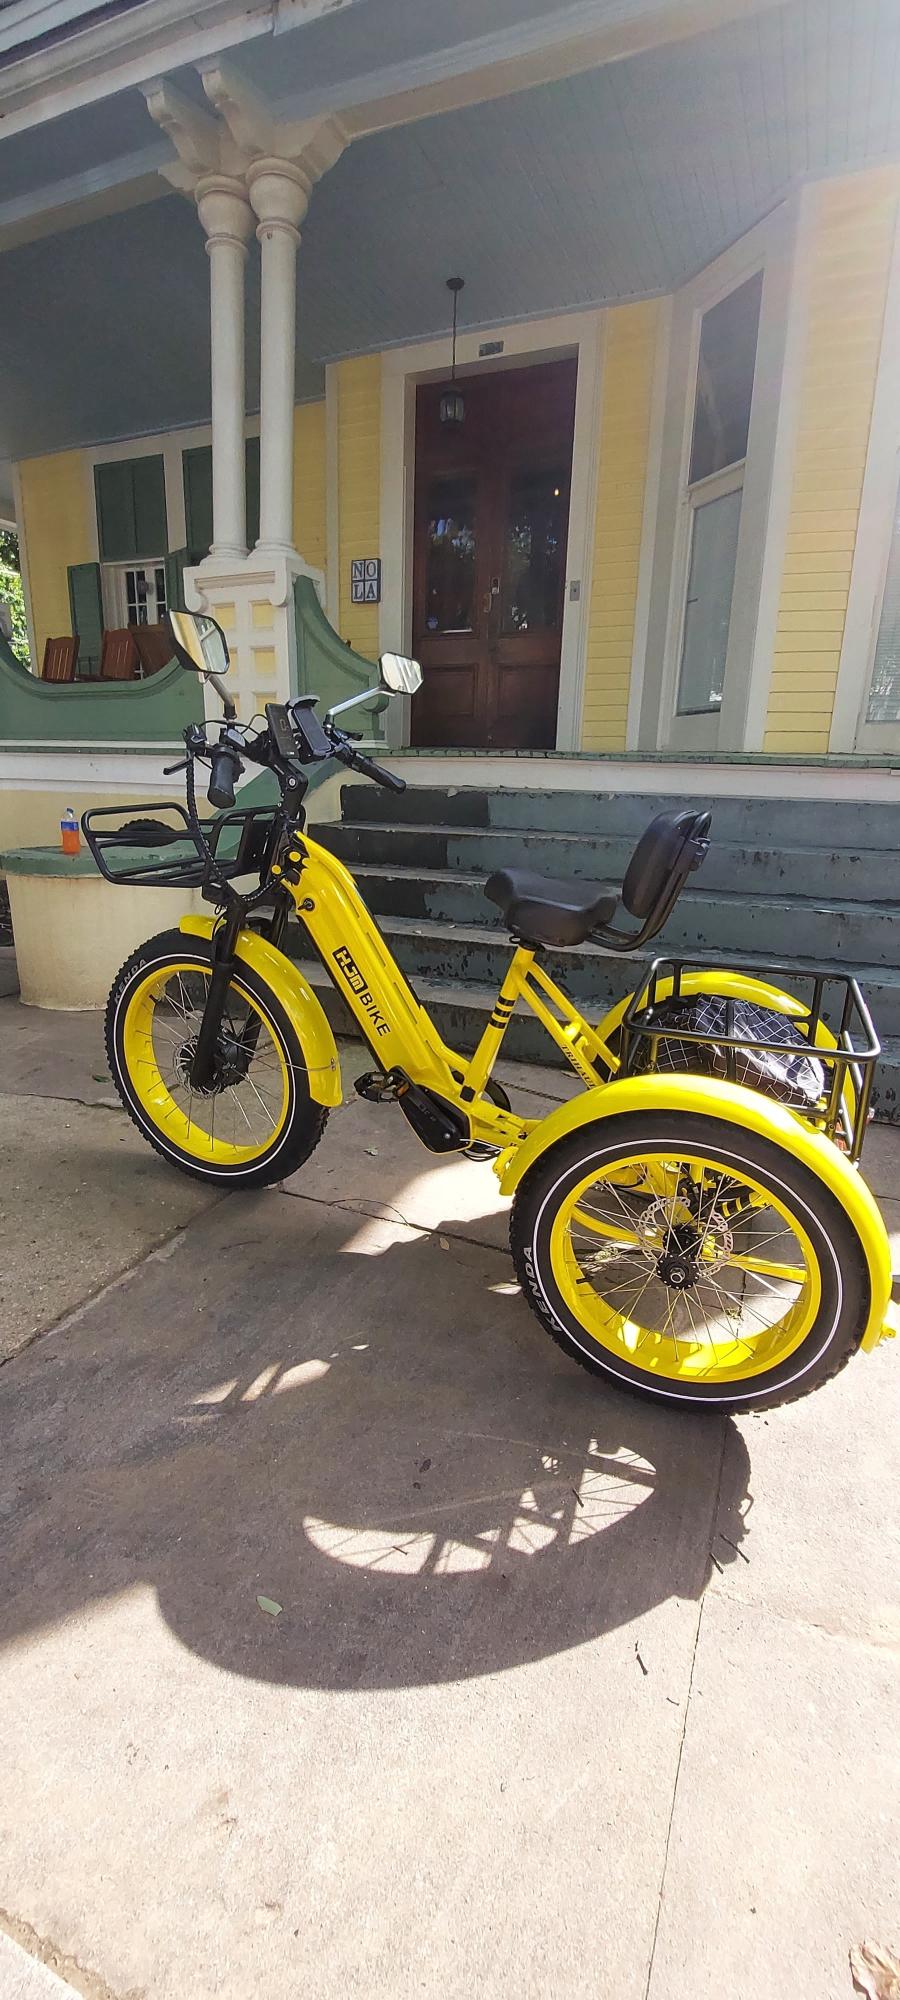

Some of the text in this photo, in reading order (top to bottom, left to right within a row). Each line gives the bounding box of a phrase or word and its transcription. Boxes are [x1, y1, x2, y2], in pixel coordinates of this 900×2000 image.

[114, 959, 147, 1004] KENDA
[359, 992, 391, 1036] BIKE
[523, 1247, 562, 1332] KENDA
